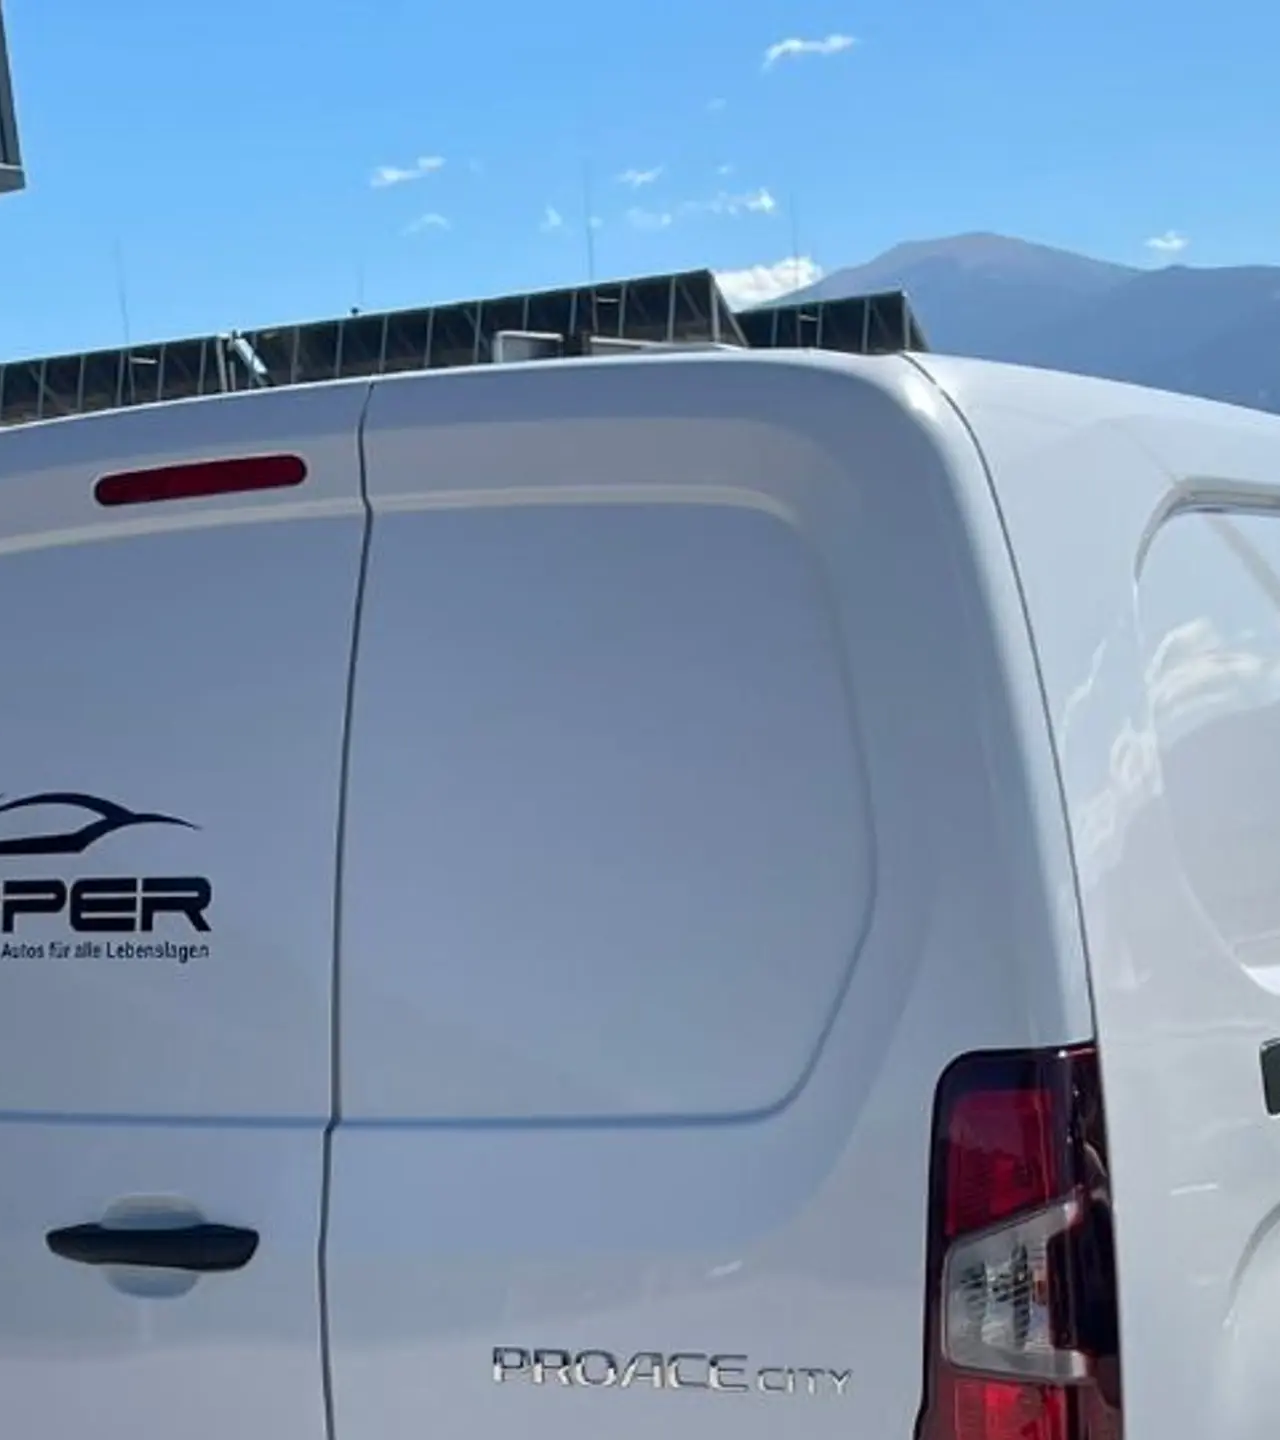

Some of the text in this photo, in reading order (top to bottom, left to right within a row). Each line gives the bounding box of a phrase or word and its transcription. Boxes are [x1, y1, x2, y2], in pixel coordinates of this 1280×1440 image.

[1, 941, 210, 964] Autos für alle Lebenslagen
[492, 1346, 853, 1395] PROACE CITY
